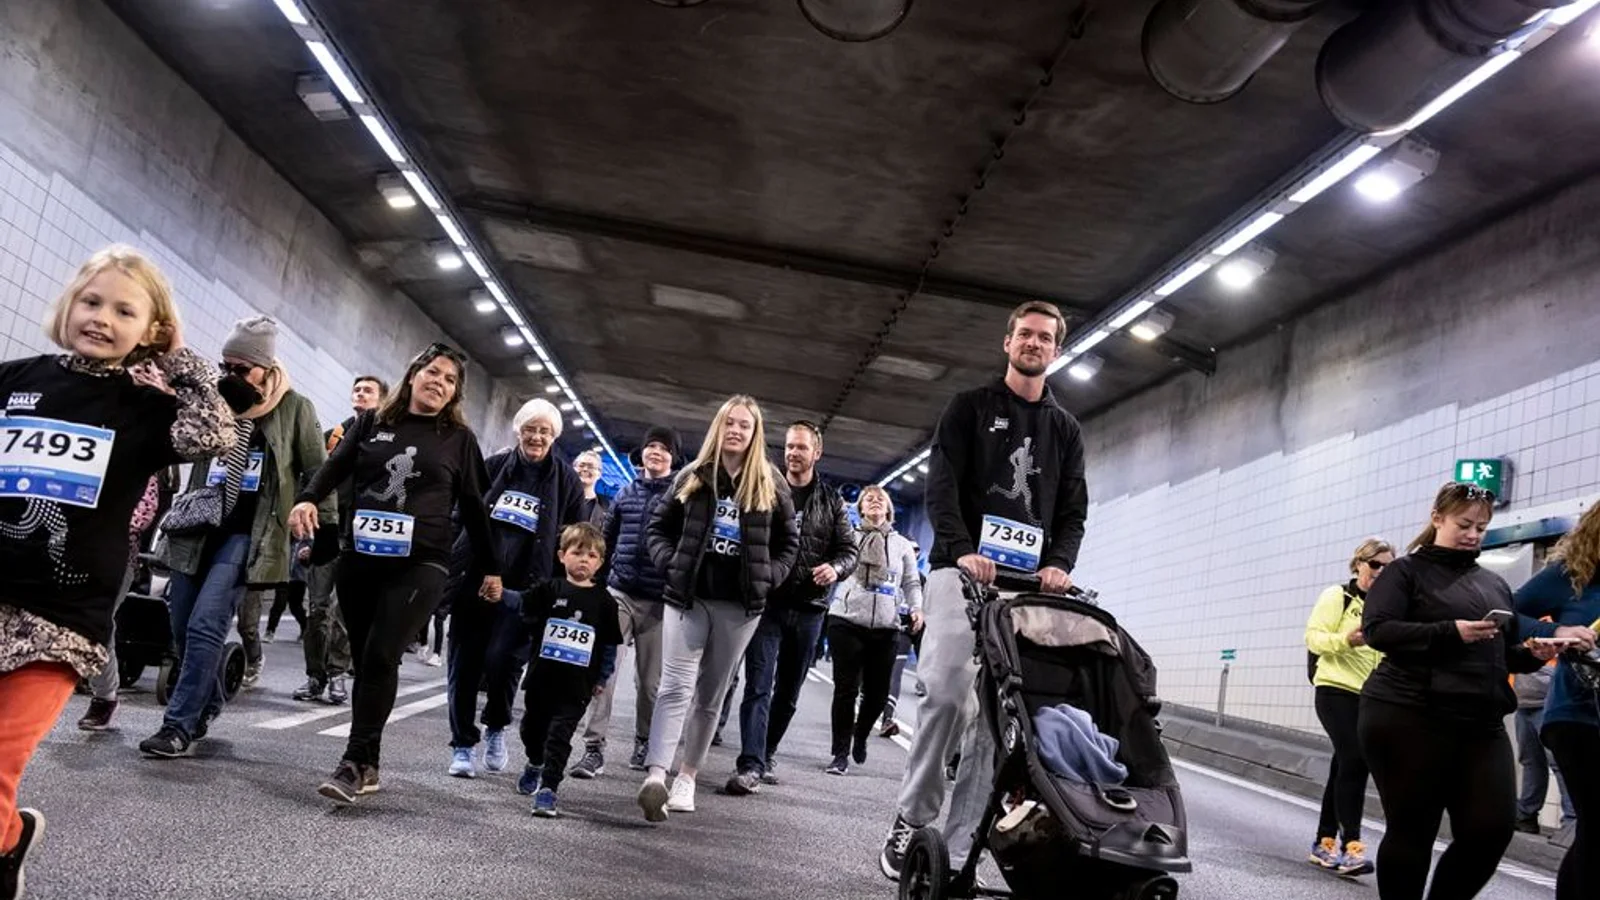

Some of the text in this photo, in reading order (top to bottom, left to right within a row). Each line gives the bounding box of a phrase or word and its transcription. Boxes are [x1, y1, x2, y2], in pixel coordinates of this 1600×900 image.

[4, 428, 97, 462] 7493
[503, 495, 540, 515] 9156
[359, 516, 406, 535] 7351
[989, 522, 1037, 547] 7349
[549, 624, 590, 644] 7348
